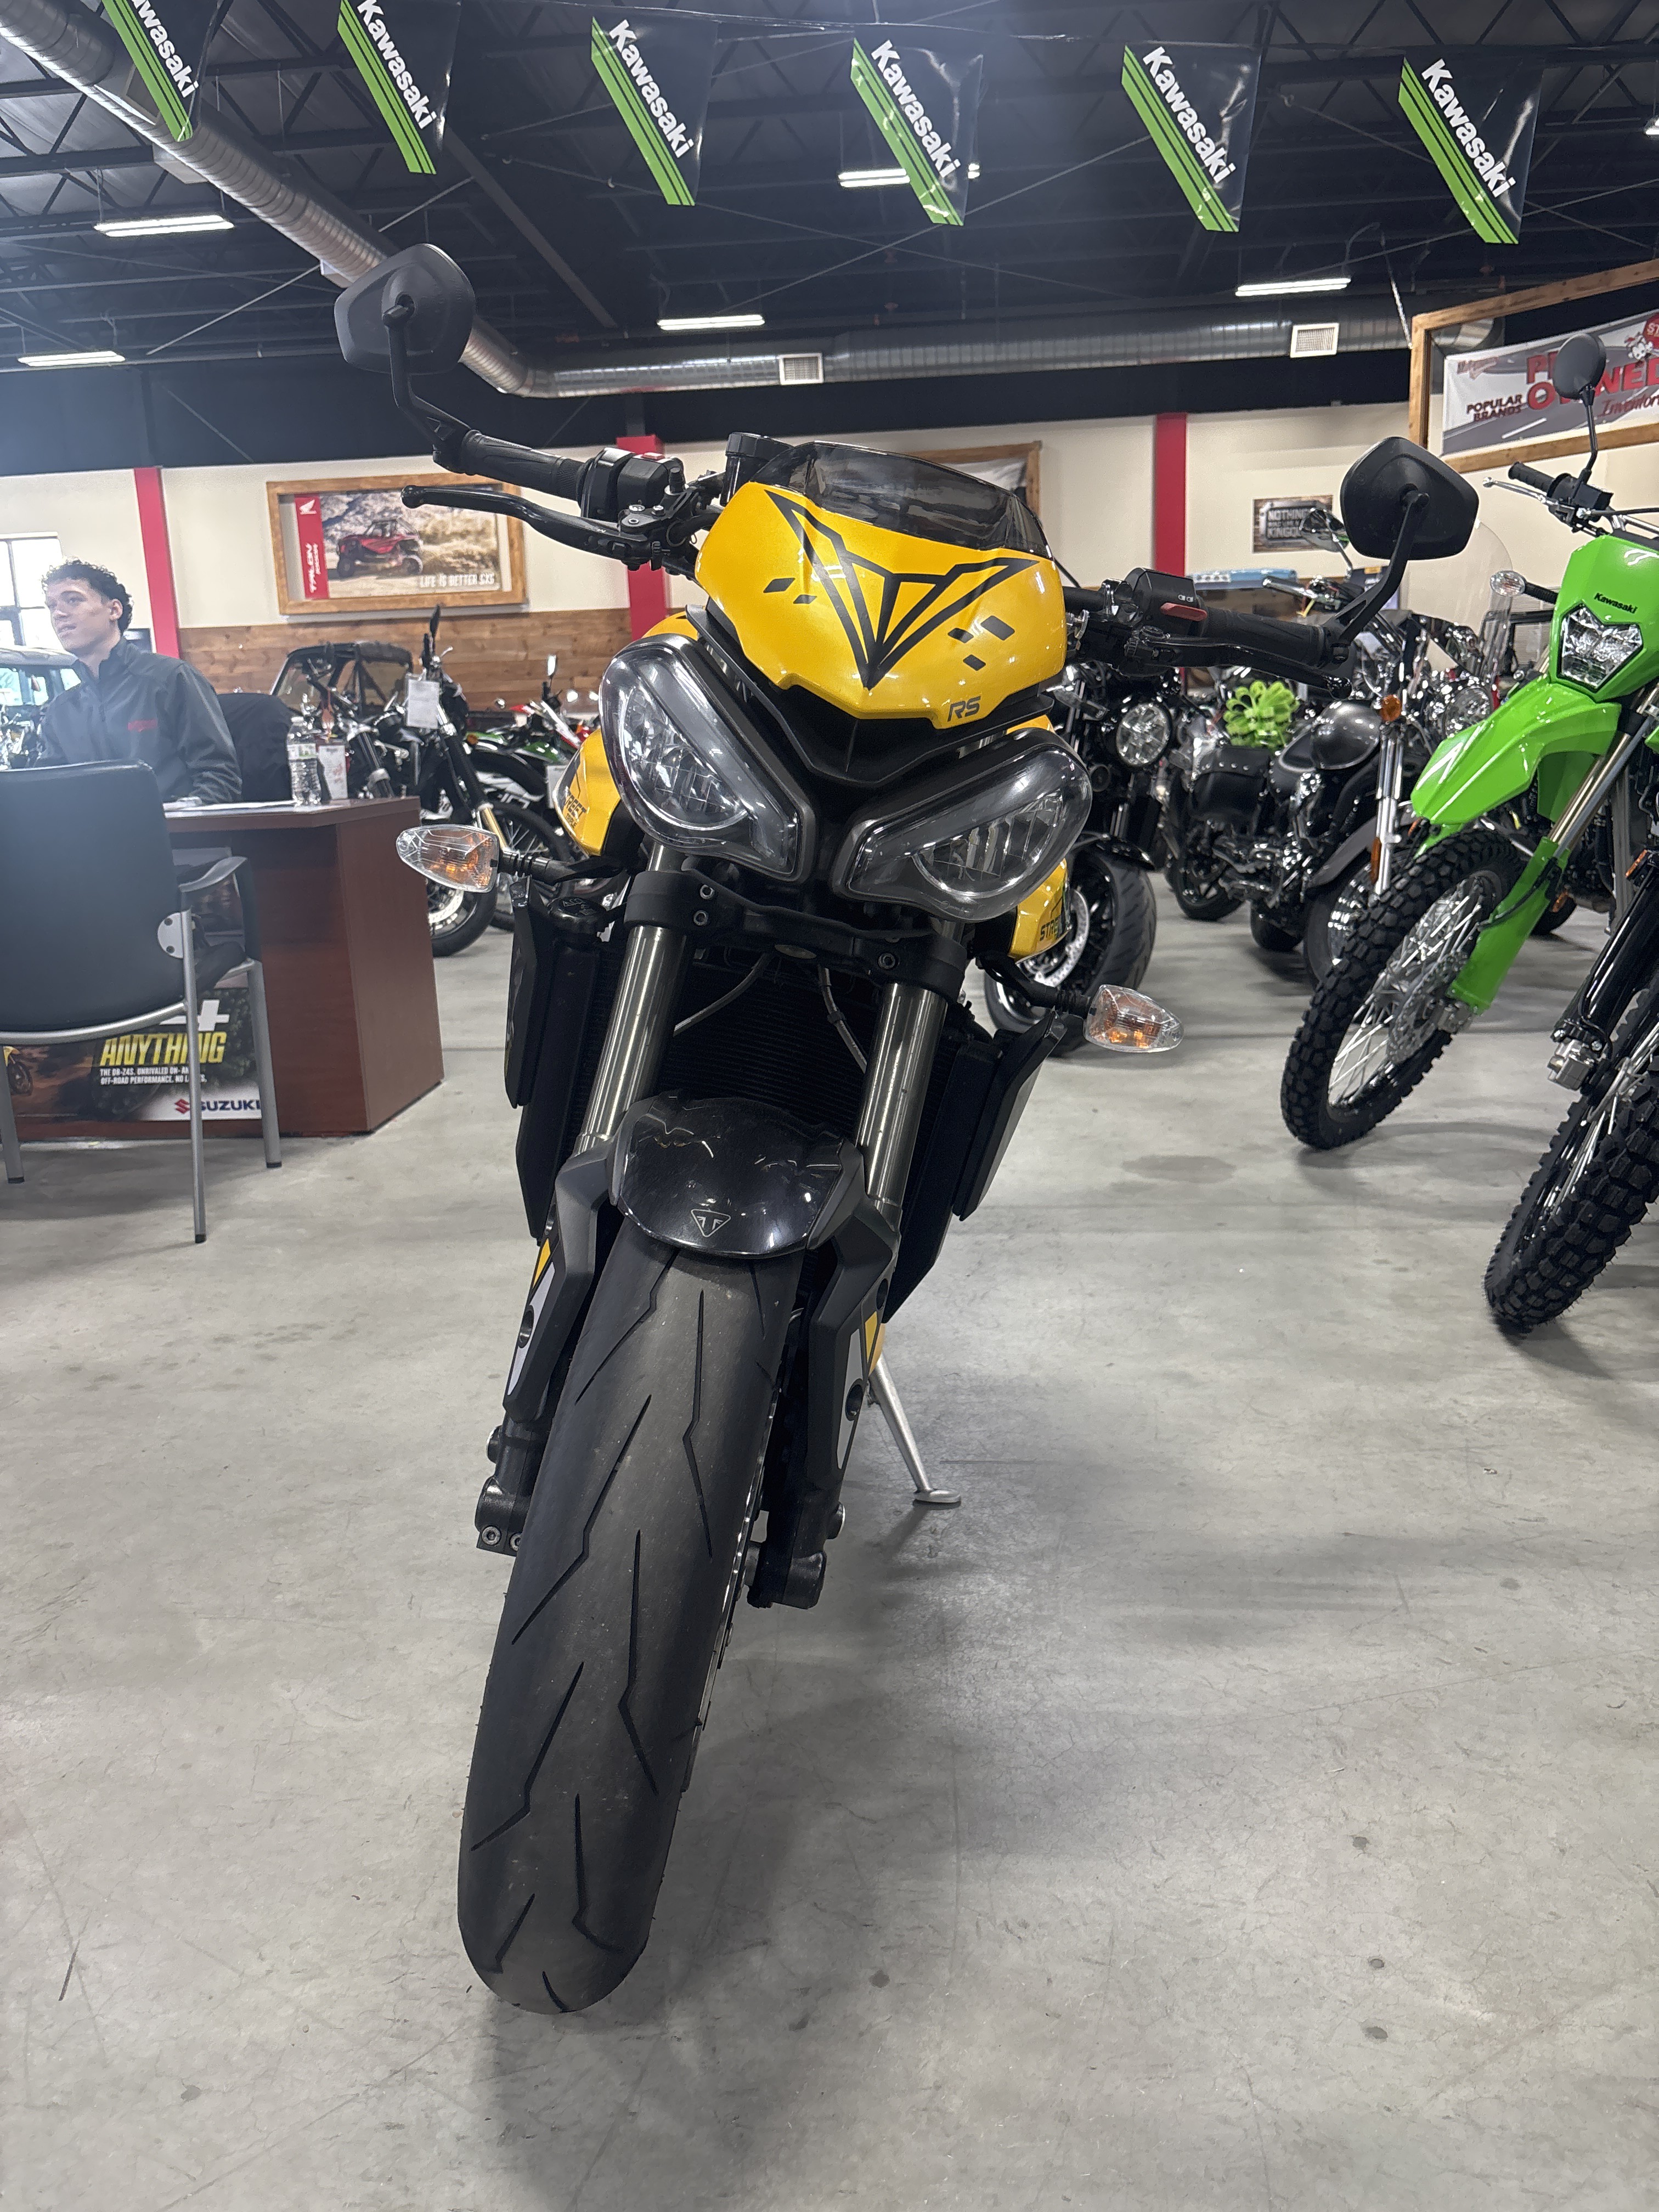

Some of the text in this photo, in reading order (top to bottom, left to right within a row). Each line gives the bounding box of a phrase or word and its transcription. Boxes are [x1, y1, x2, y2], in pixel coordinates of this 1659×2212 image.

[132, 0, 199, 98] wasaki
[357, 0, 437, 129] Kawasaki
[609, 19, 695, 158] Kawasaki
[871, 40, 961, 178] Kawasaki
[1142, 46, 1236, 183] Kawasaki
[1421, 58, 1516, 198] Kawasaki
[1466, 394, 1522, 414] POPULAR
[1474, 405, 1521, 422] BRANDS
[1527, 357, 1659, 410] ONED
[1594, 592, 1638, 614] Kawasaki
[947, 696, 981, 722] RS
[100, 1031, 227, 1067] ANYTHING
